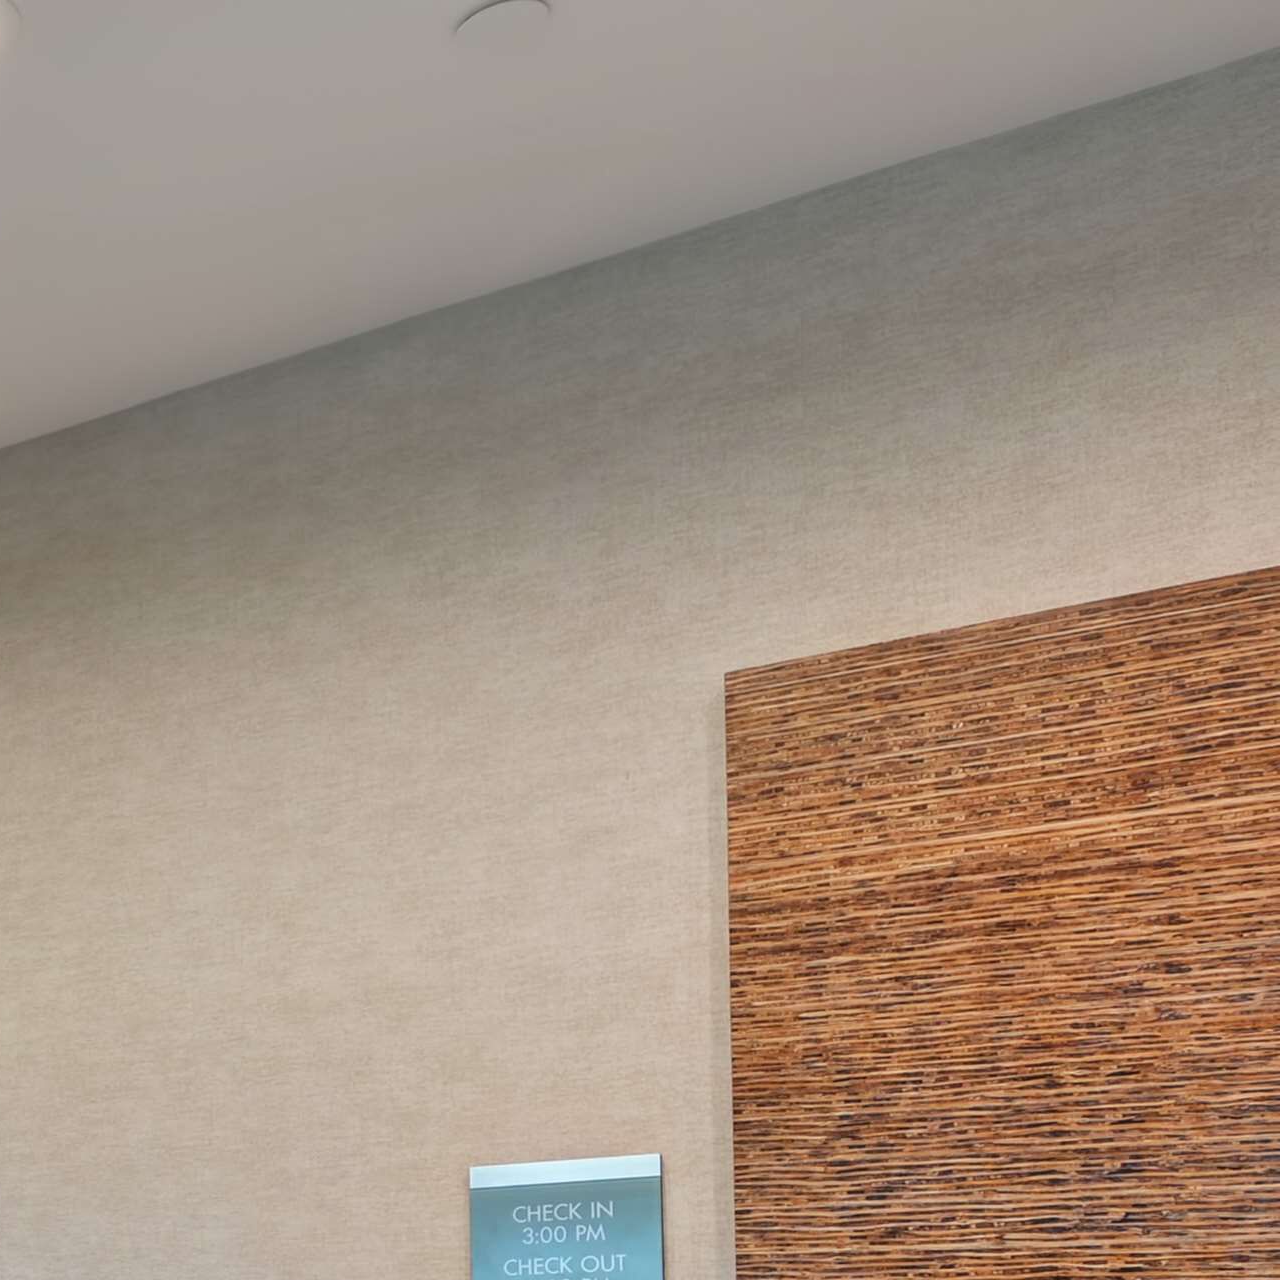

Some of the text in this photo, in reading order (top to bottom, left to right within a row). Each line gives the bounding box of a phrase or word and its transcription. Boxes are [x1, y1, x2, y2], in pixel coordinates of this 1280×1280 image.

[513, 1201, 614, 1224] CHECK IN
[522, 1225, 606, 1245] 3:00 PM
[503, 1254, 626, 1277] CHECK OUT
